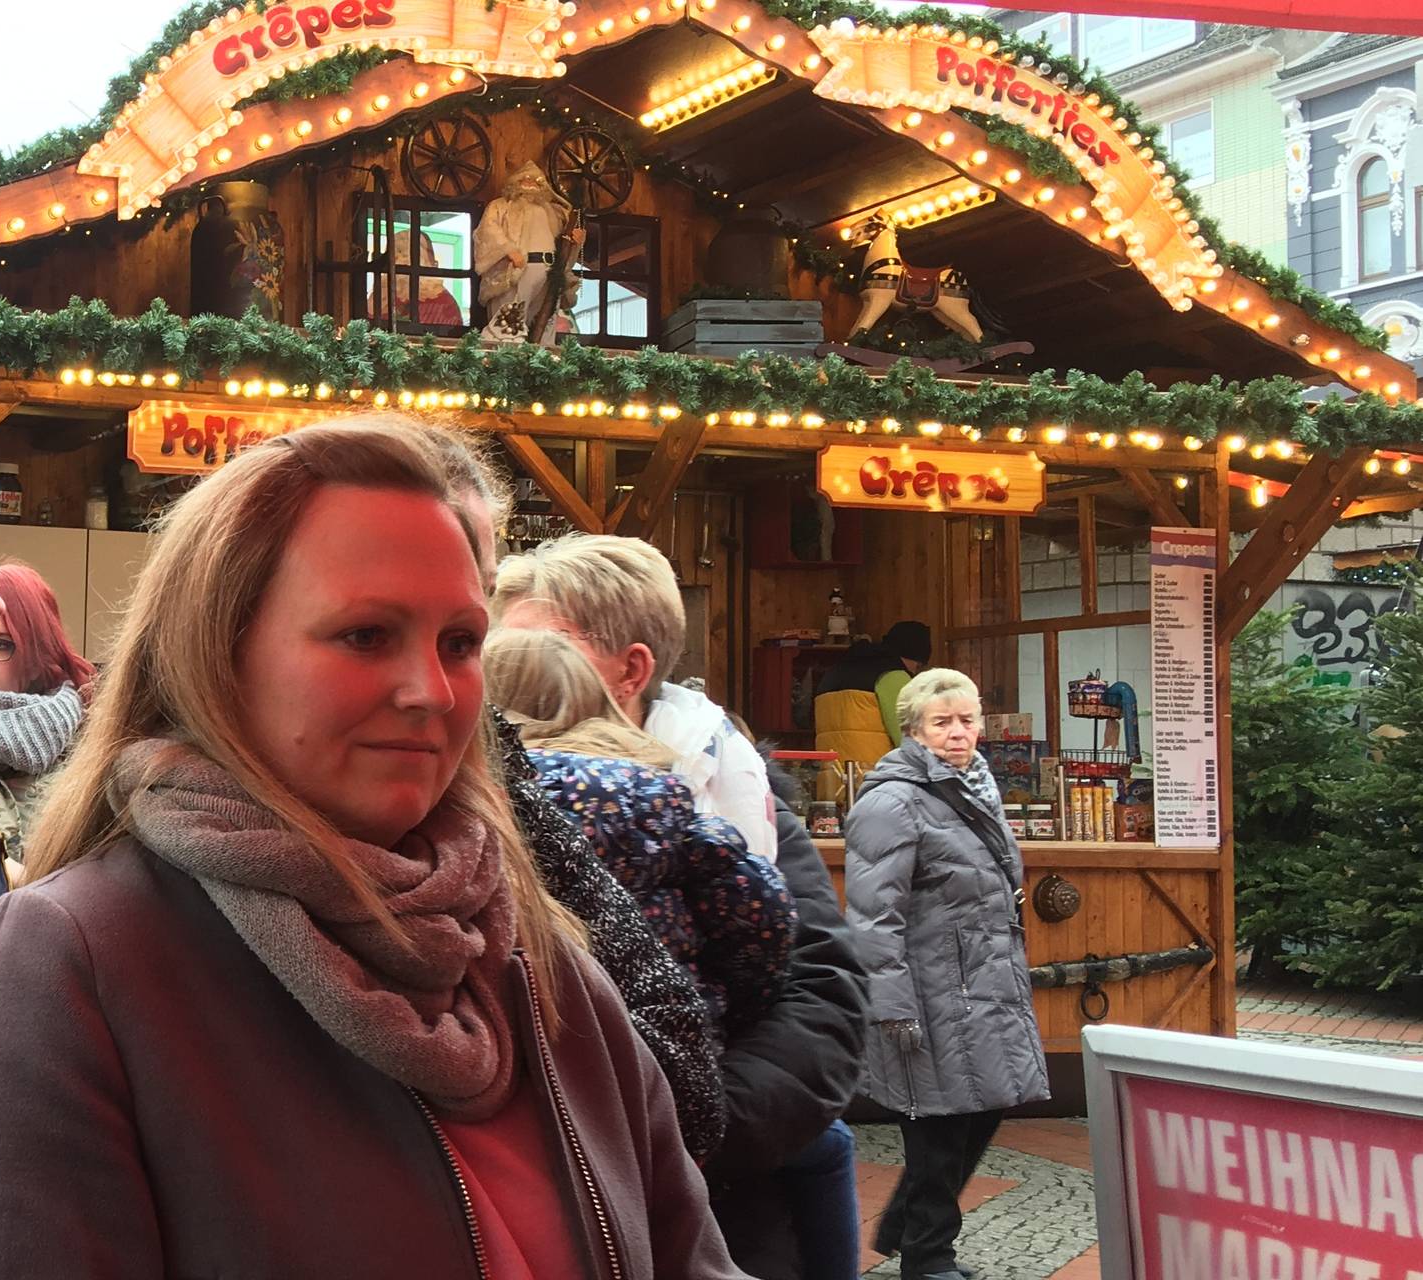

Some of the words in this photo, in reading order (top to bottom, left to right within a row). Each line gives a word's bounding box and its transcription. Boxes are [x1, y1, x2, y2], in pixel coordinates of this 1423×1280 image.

[212, 0, 396, 77] Crêpes
[936, 47, 1120, 167] Poffertjes
[859, 455, 1009, 510] Crêpes
[1161, 541, 1207, 558] Crepes
[1147, 1108, 1423, 1238] WEIHNA
